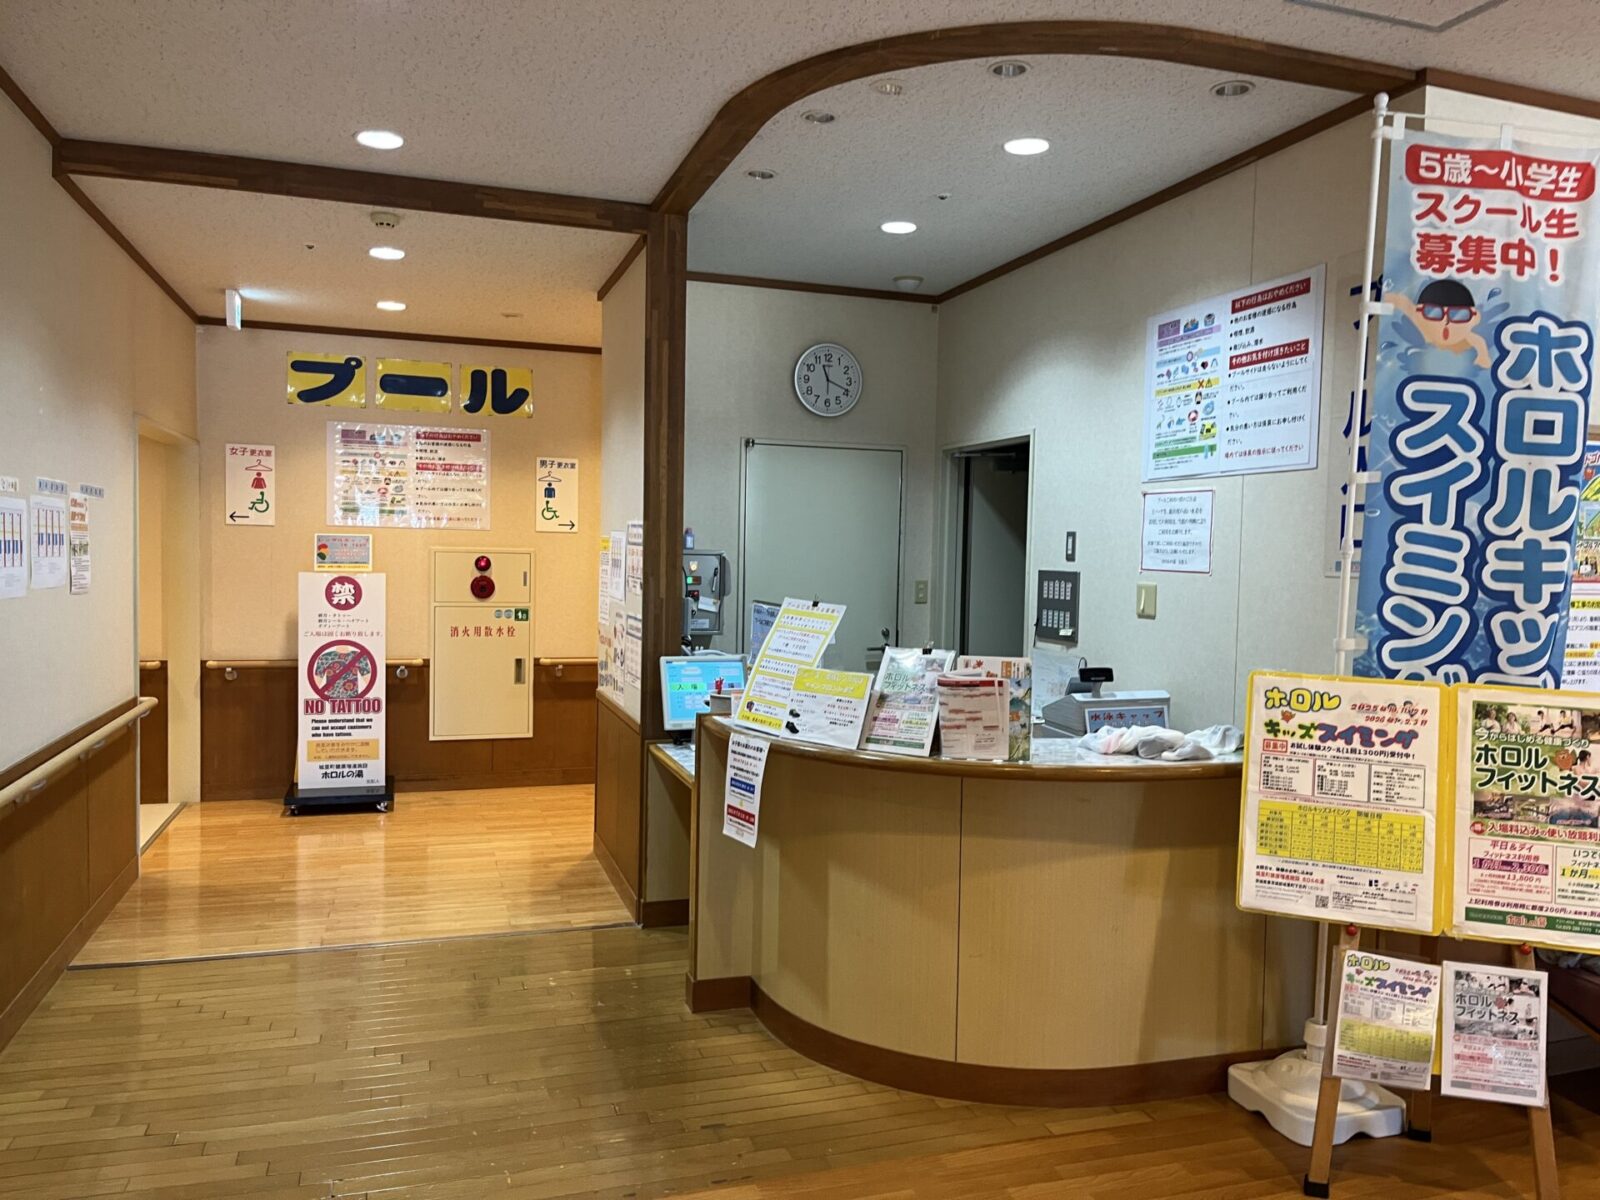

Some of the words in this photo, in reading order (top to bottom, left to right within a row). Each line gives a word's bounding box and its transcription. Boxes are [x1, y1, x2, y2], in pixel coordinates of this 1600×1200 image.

[1415, 192, 1579, 239] スクール生
[1416, 232, 1559, 283] 募集中！
[815, 355, 821, 364] 11
[824, 353, 832, 362] 12
[838, 357, 841, 366] 1
[806, 363, 815, 372] 10
[843, 366, 850, 375] 2
[803, 374, 810, 384] 9
[846, 377, 852, 386] 3
[289, 356, 530, 415] プール
[806, 386, 813, 395] 8
[843, 389, 849, 397] 4
[814, 395, 820, 404] 7
[824, 399, 831, 408] 6
[835, 396, 841, 405] 5
[539, 459, 576, 469] 男子更衣室
[1479, 318, 1589, 688] ホロルキッ
[1383, 382, 1482, 686] スイミン
[331, 582, 355, 605] 禁
[450, 626, 515, 638] 消火用散水栓
[884, 672, 909, 681] ホロル
[884, 681, 928, 692] フィットネス
[1265, 686, 1342, 712] ホロル
[304, 699, 325, 714] NO
[330, 697, 382, 714] TATTOO
[1264, 719, 1419, 749] キッズスイミング
[1475, 728, 1590, 748] 今からはじめる健康づくり
[1475, 744, 1548, 769] ホロル
[321, 770, 363, 779] ホロルの湯
[1475, 767, 1600, 797] フィットネス
[1347, 954, 1390, 971] ホロル
[1456, 993, 1492, 1007] ホロル
[1456, 1005, 1519, 1024] フィットネス
